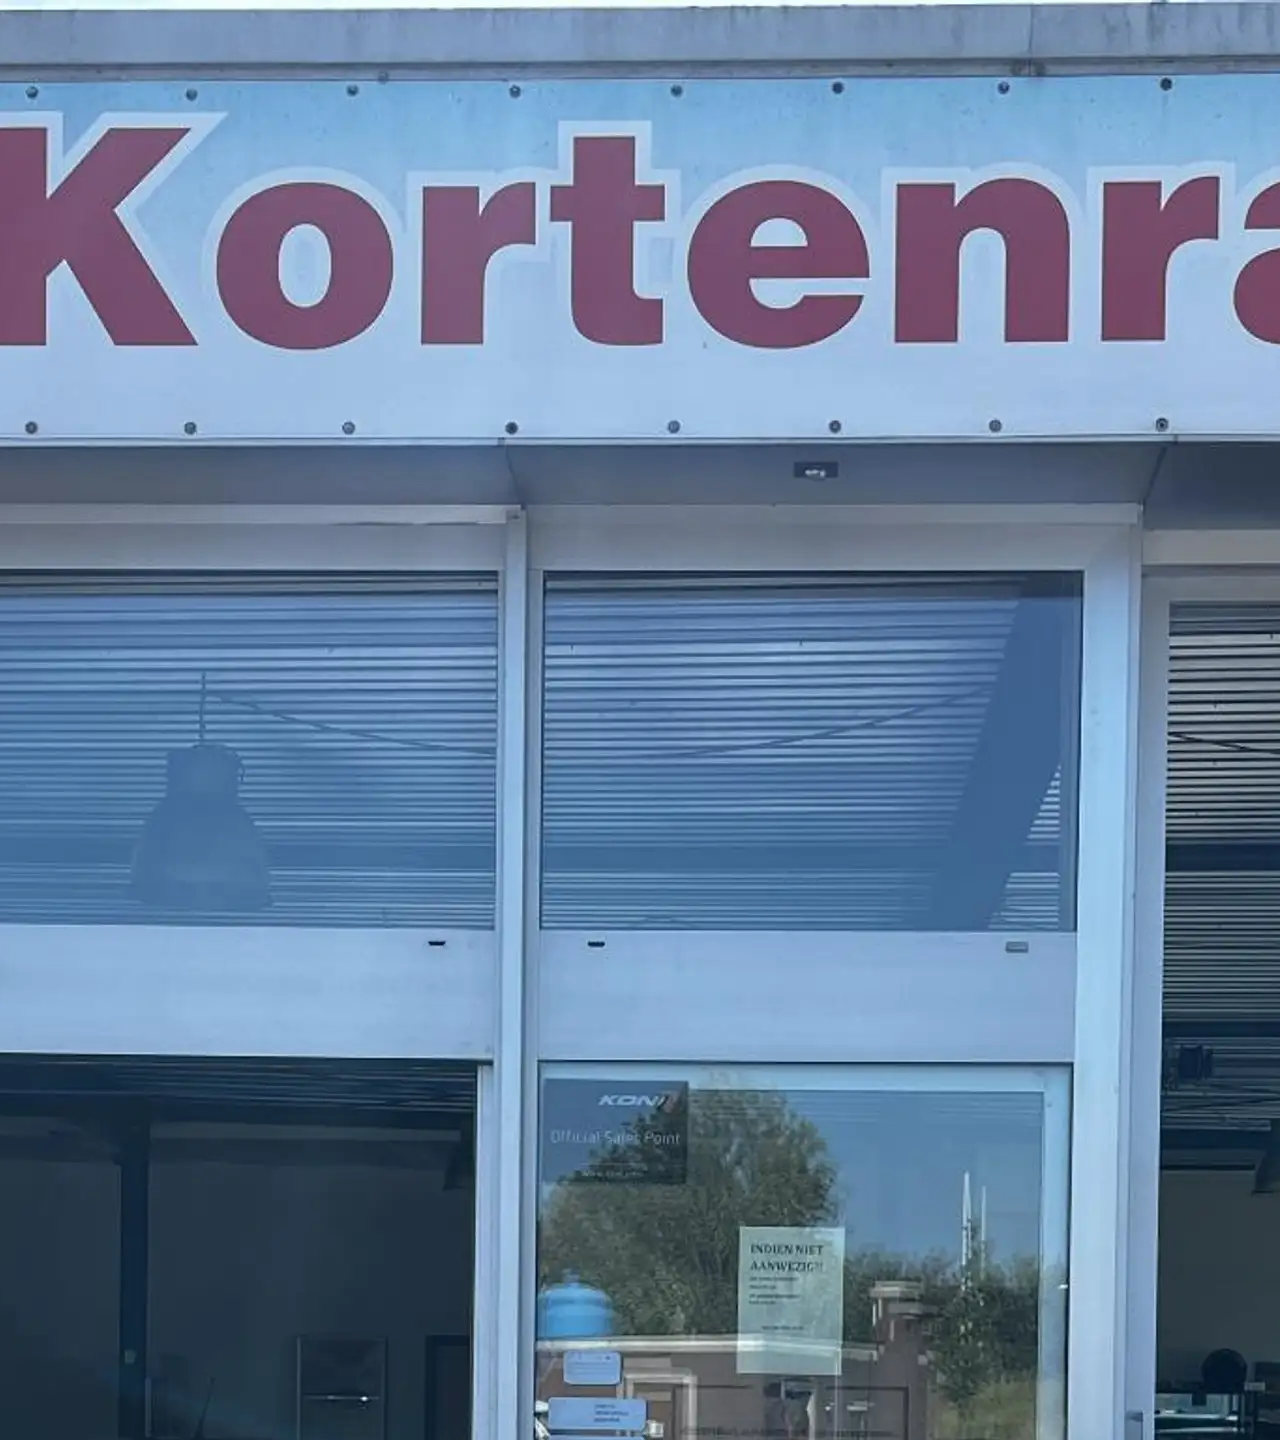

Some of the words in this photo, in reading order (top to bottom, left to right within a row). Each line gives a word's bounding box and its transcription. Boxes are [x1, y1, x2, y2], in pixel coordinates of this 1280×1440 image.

[550, 1129, 600, 1144] Official
[644, 1131, 680, 1145] Point
[750, 1244, 793, 1256] INDIEN
[795, 1244, 823, 1256] NIET
